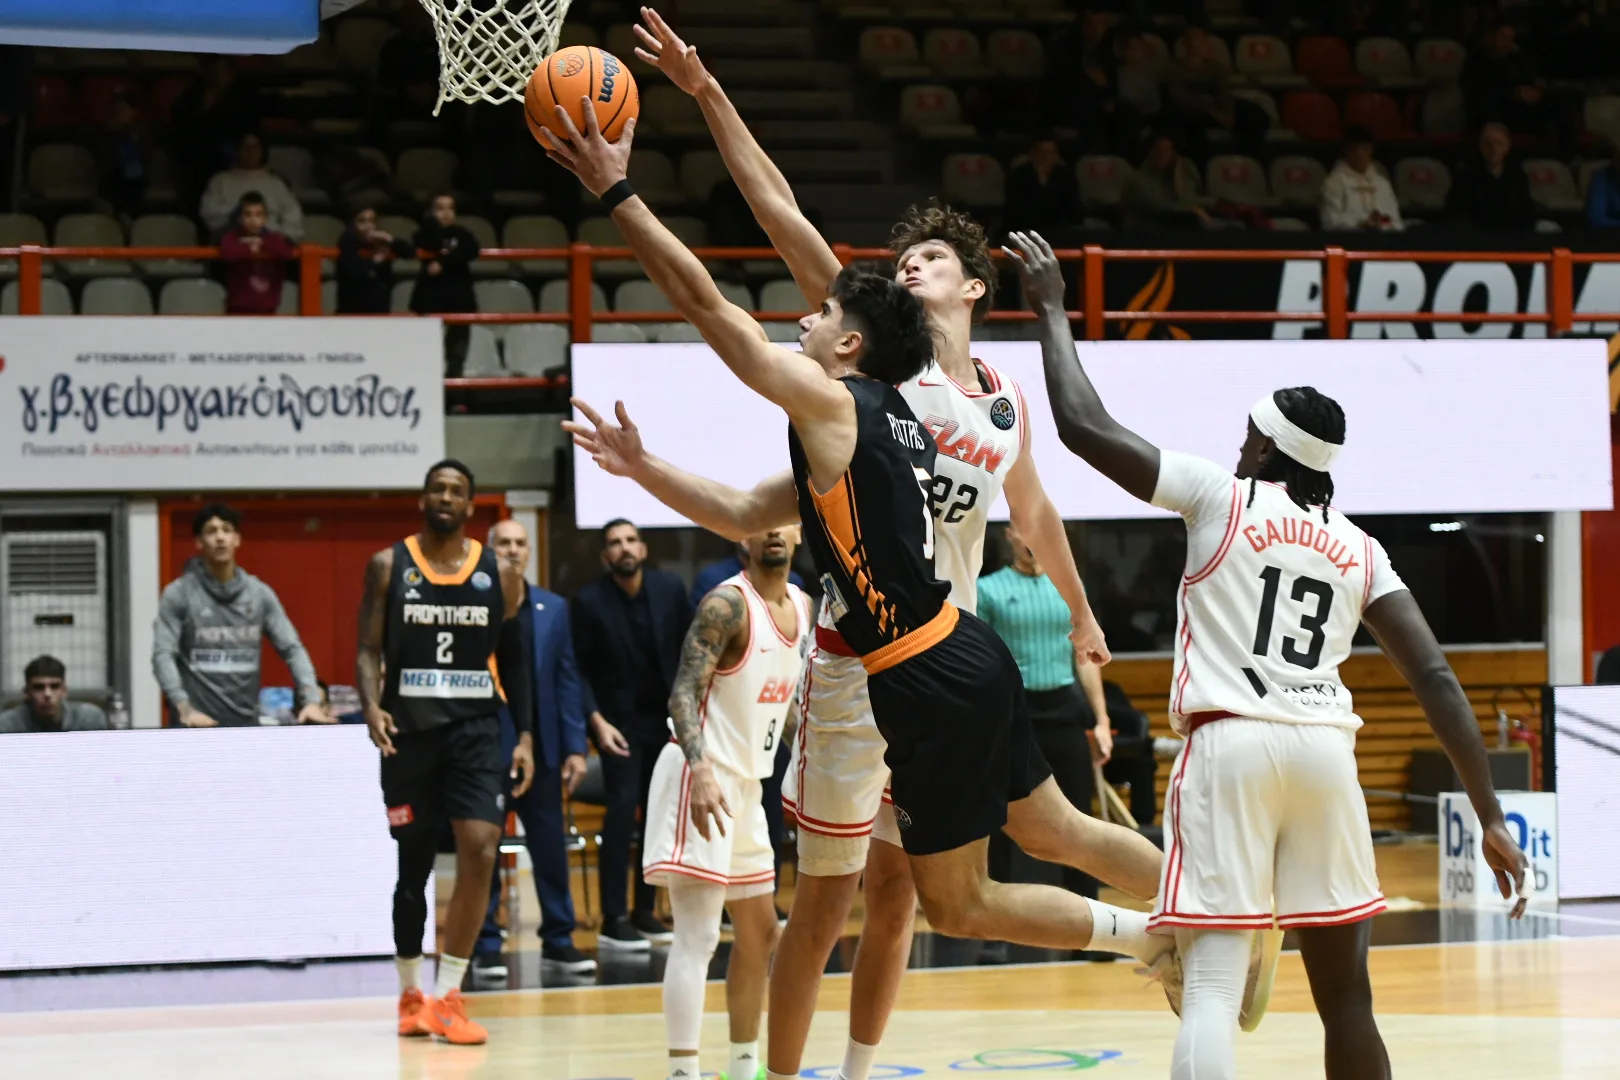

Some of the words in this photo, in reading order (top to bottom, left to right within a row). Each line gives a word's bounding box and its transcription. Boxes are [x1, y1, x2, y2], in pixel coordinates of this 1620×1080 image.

[932, 474, 979, 524] 22
[1243, 517, 1359, 578] GAUDOUX
[1252, 565, 1334, 671] 13
[436, 632, 453, 664] 2
[403, 672, 438, 687] MED
[441, 673, 491, 688] FRIGO
